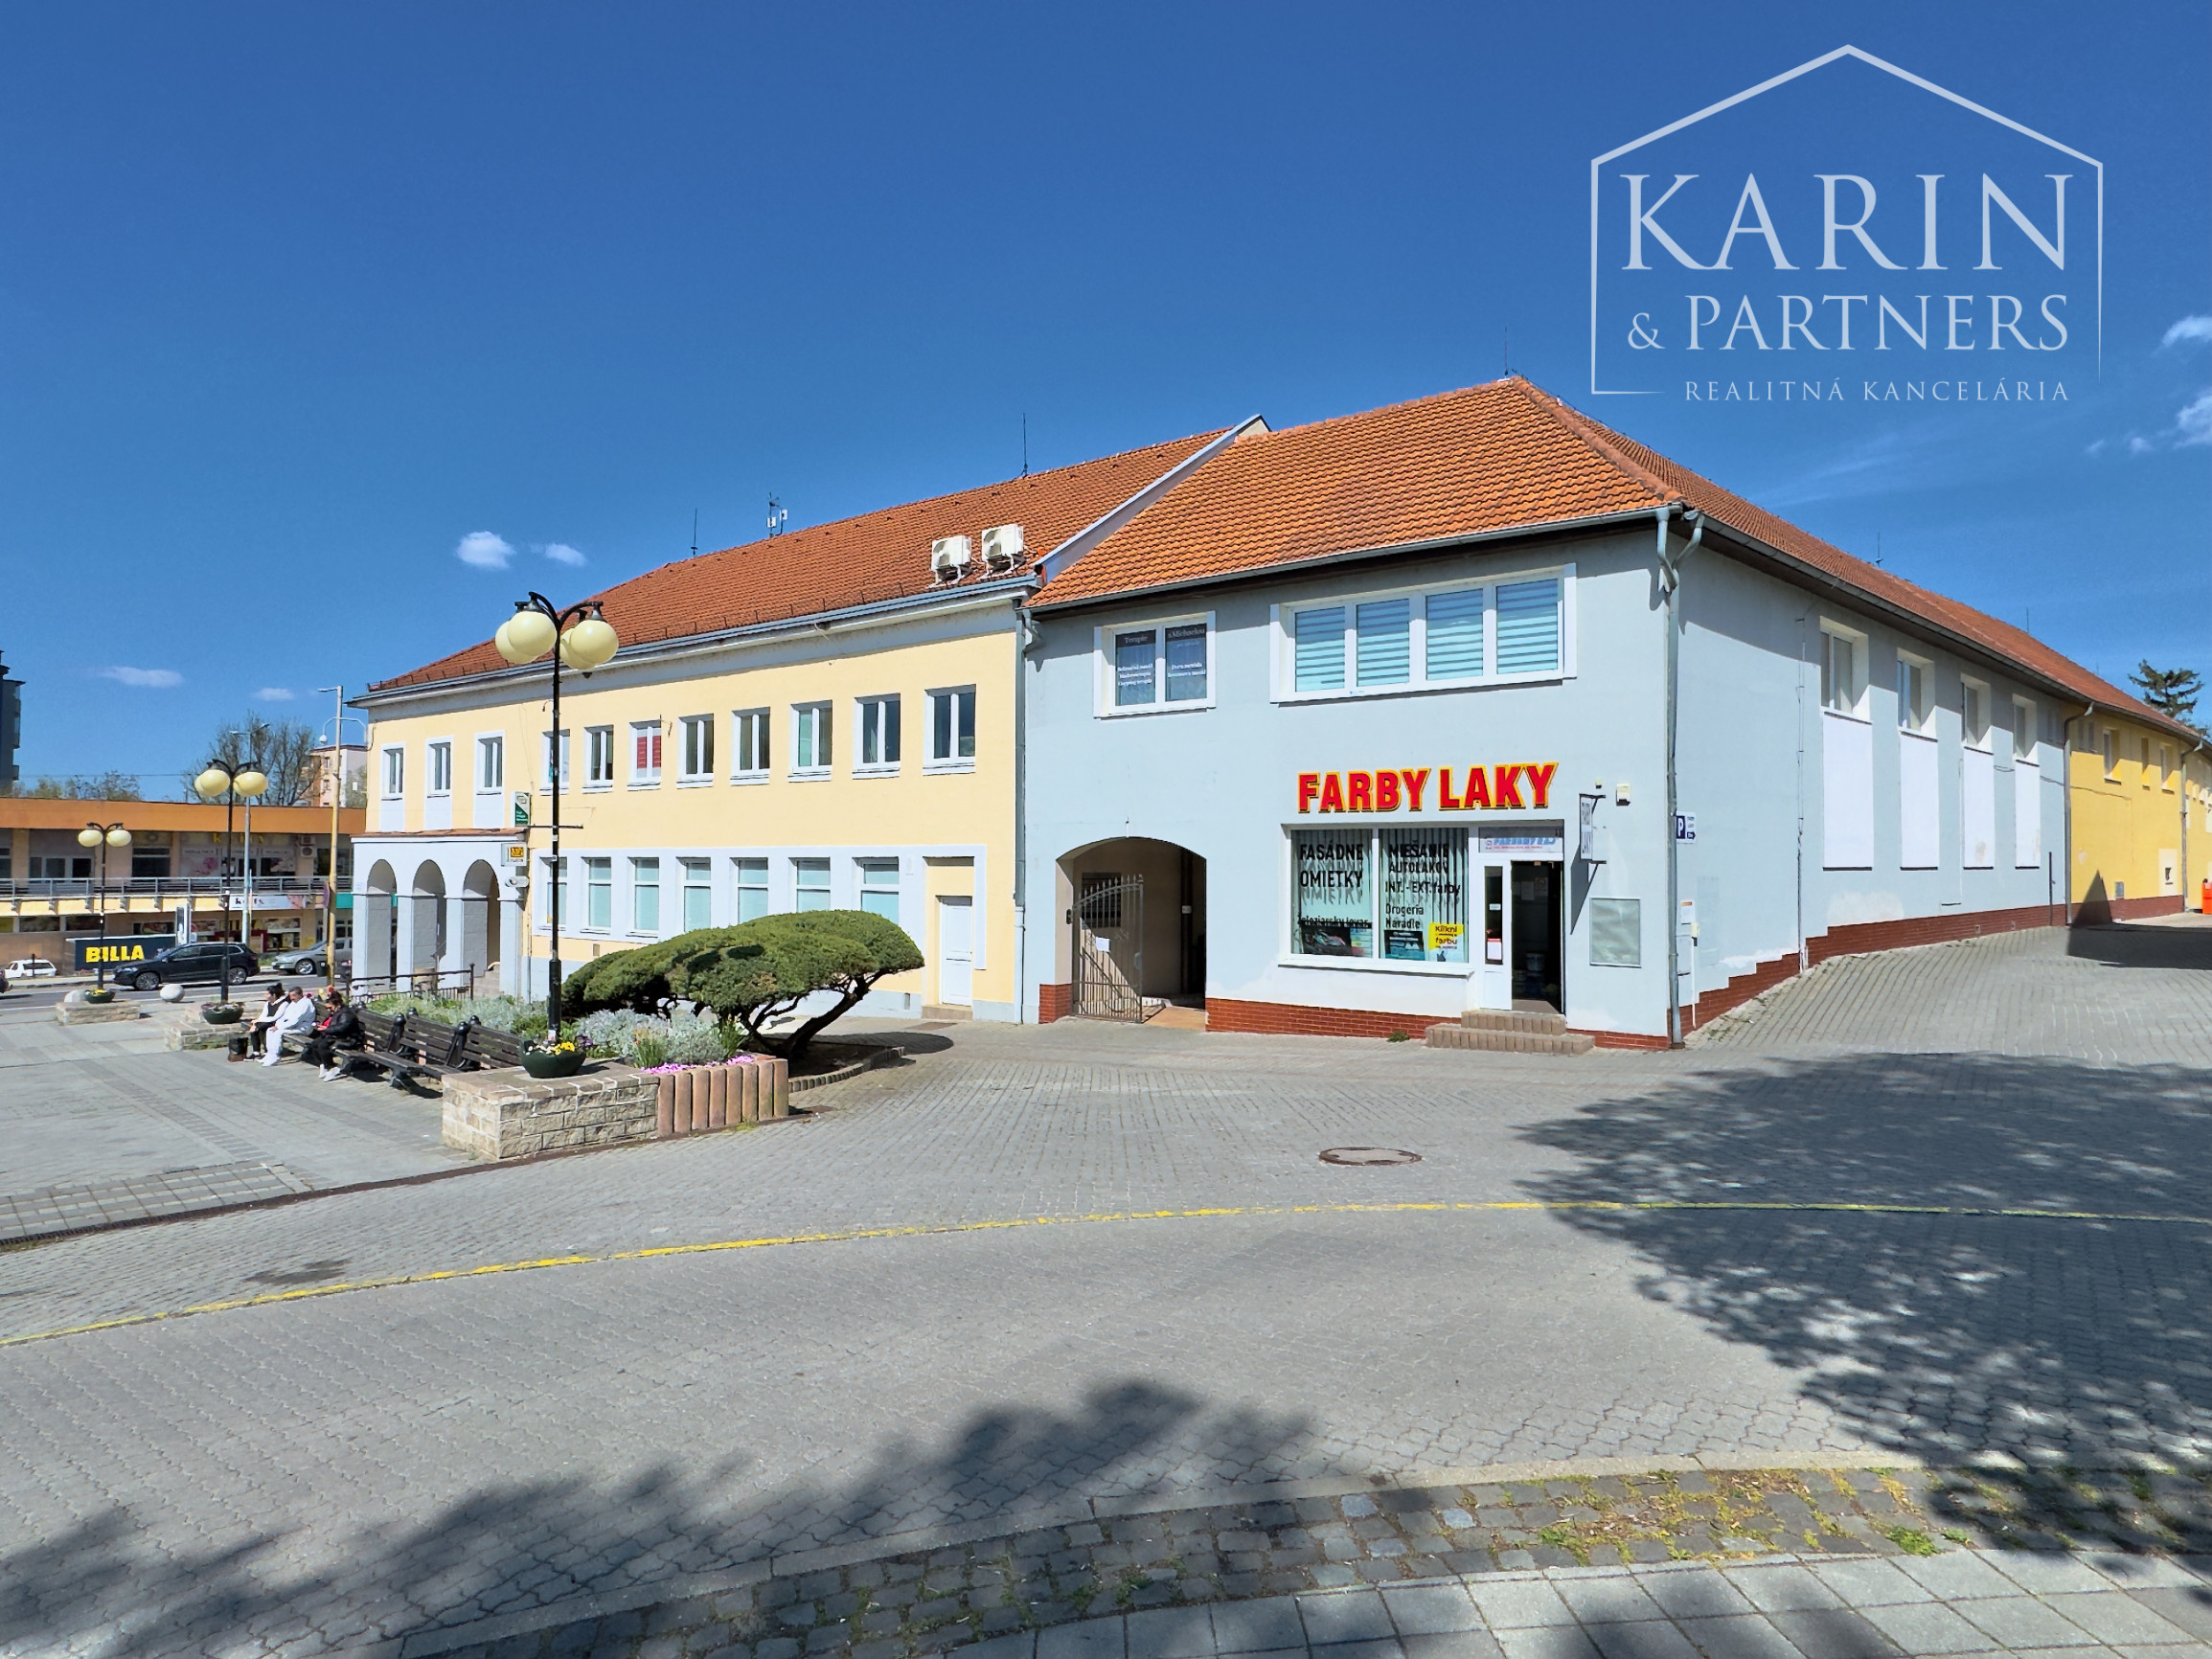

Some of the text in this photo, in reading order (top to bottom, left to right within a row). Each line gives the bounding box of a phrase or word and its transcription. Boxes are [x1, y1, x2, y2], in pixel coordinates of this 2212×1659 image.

[1297, 761, 1559, 813] FARBY LAKY
[1677, 817, 1684, 837] P
[1299, 839, 1364, 861] FASÁDNE
[1300, 870, 1363, 888] OMIETKY
[86, 944, 145, 963] BILLA
